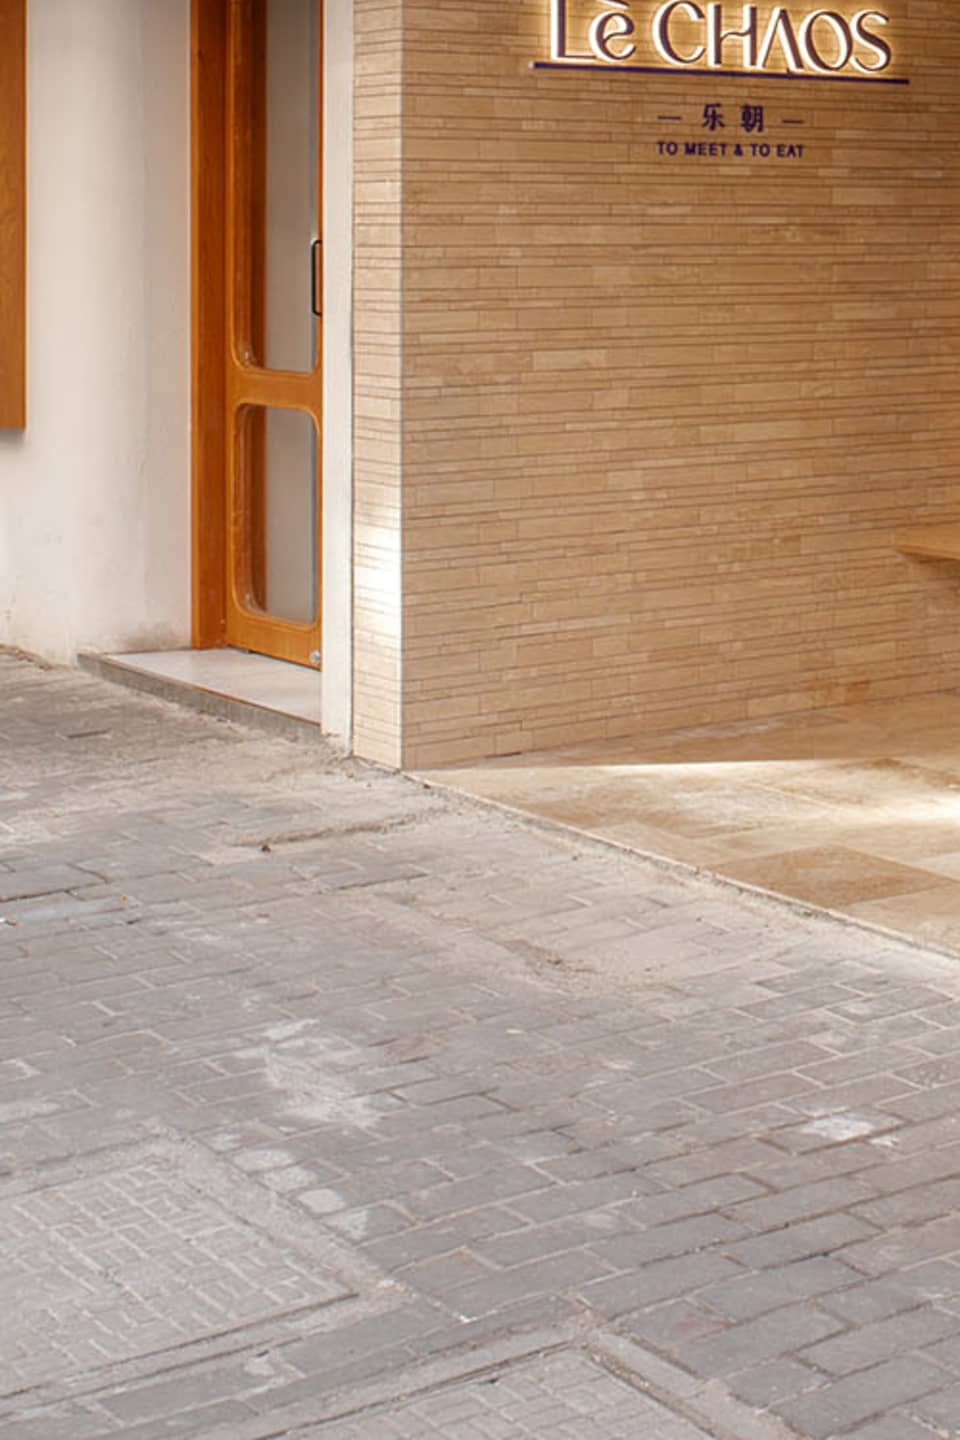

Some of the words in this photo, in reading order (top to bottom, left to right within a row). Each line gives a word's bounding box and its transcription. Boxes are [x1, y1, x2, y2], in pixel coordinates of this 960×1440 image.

[702, 103, 764, 133] 乐朝
[657, 141, 679, 156] TO
[684, 141, 727, 157] MEET
[733, 143, 744, 157] &
[751, 143, 771, 158] TO
[776, 143, 804, 158] EAT
